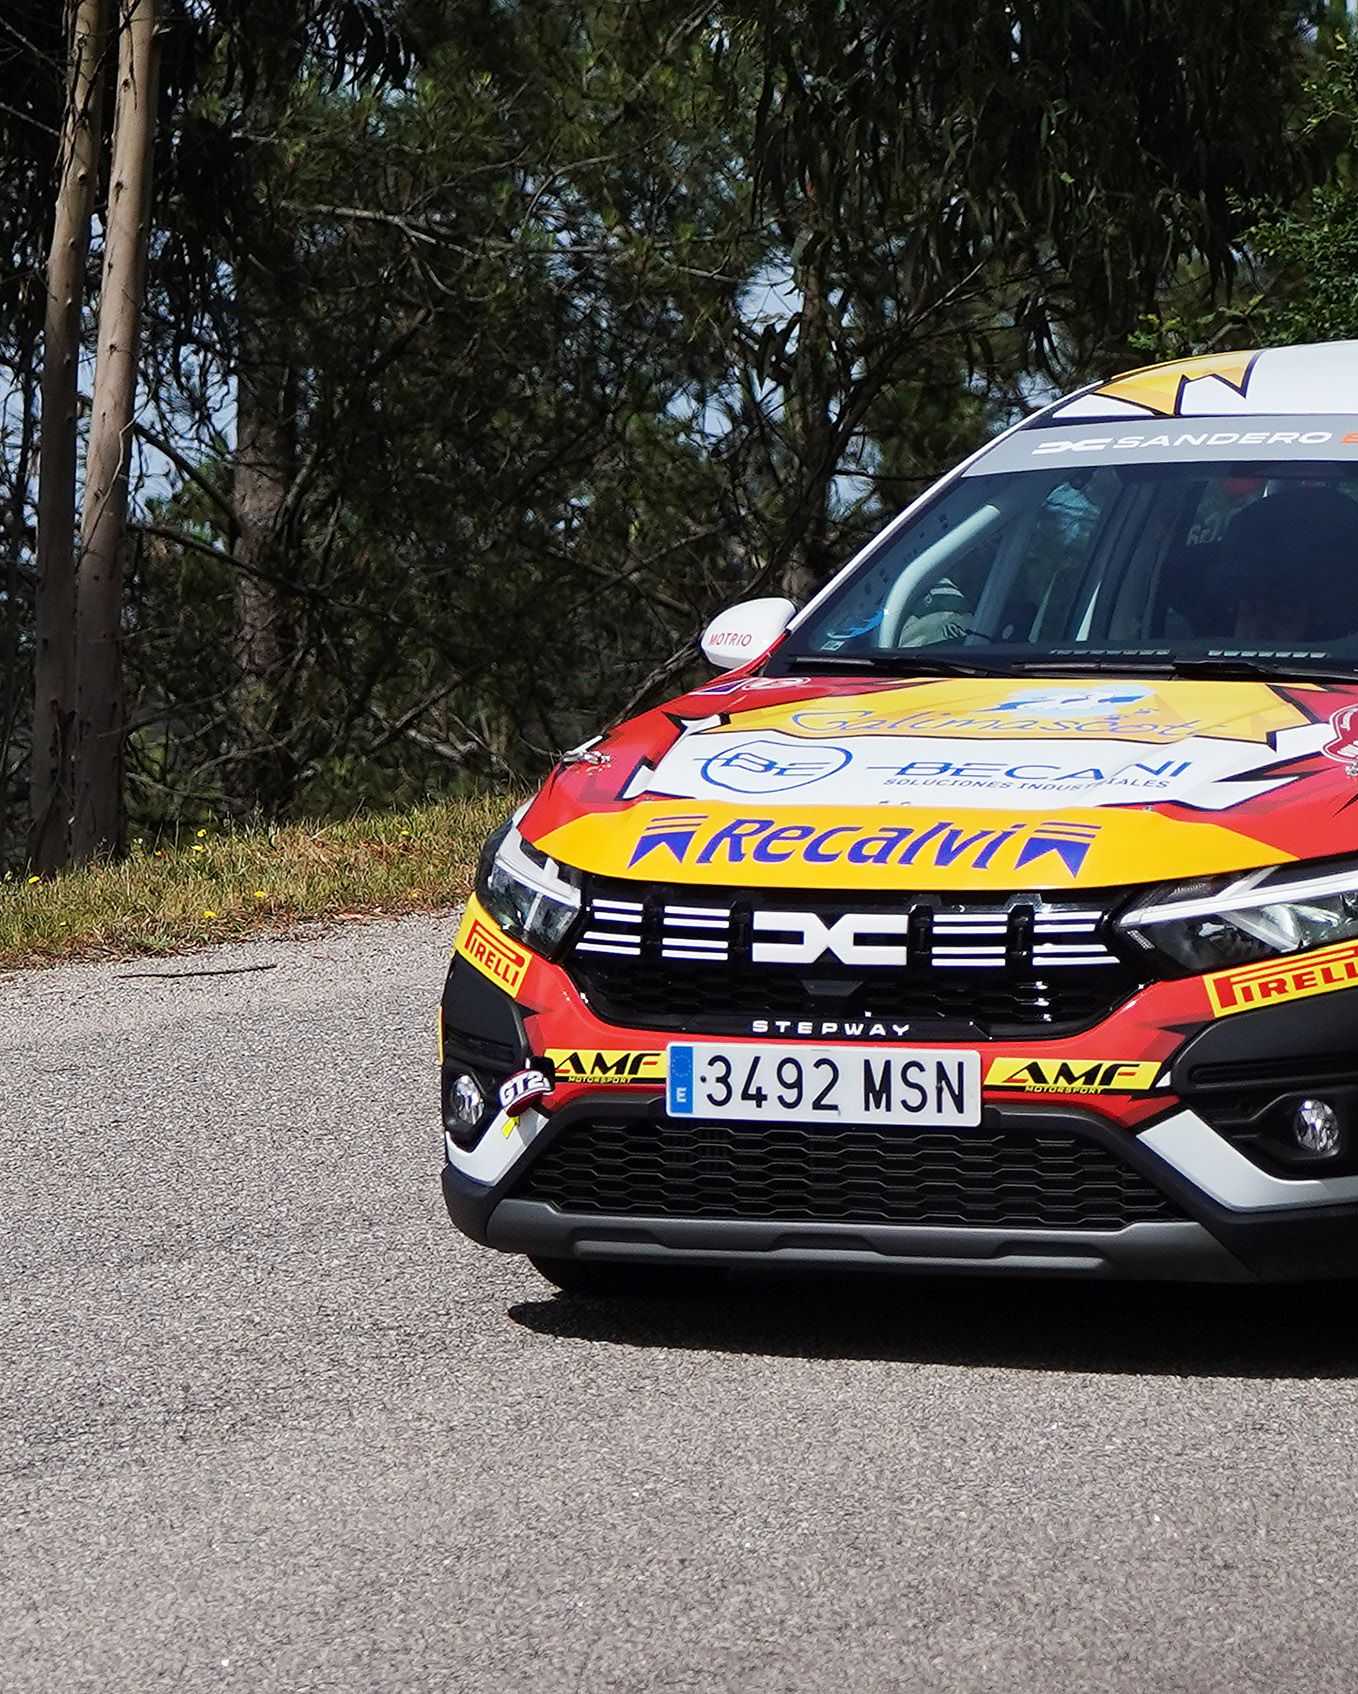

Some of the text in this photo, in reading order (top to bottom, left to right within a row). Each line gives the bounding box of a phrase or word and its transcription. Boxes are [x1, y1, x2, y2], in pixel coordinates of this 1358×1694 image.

[1113, 431, 1332, 449] SANDERO
[708, 632, 752, 647] MOTRIO
[895, 760, 1193, 781] BECANI
[883, 777, 1171, 792] SOLUCIONES INDUSTRIALES
[698, 816, 1023, 870] Recalvi
[463, 918, 526, 988] PIRELLI
[752, 1019, 910, 1037] STEPWAY
[555, 1051, 662, 1076] AMF
[568, 1074, 633, 1084] MOTORSPORT
[1002, 1061, 1141, 1087] AMF
[706, 1053, 965, 1116] 3492 MSN
[1024, 1085, 1103, 1095] MOTORSPORT
[676, 1087, 687, 1103] E
